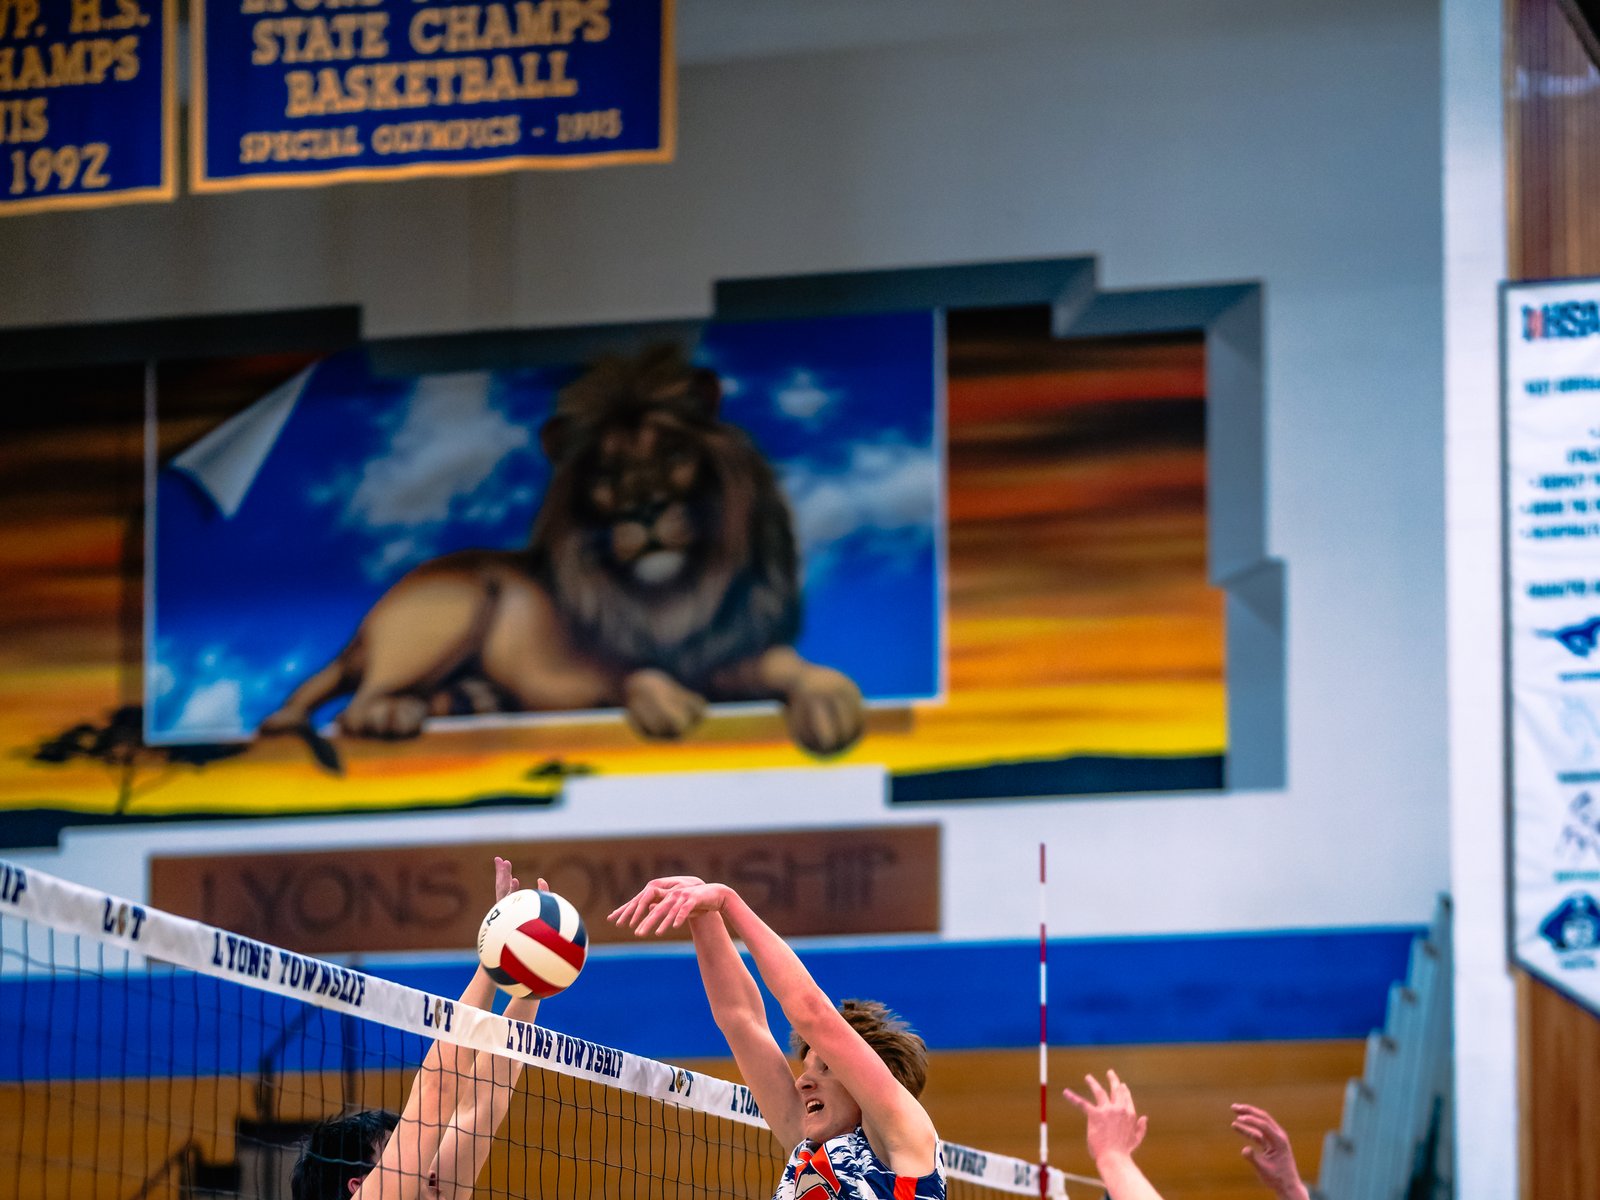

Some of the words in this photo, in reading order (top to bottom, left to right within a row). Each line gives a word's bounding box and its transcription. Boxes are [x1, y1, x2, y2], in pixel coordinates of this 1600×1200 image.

[252, 12, 389, 65] STATE
[409, 0, 611, 54] CHAMPS
[285, 50, 578, 118] BASKETBALL
[239, 125, 364, 164] SPECIAL
[371, 114, 521, 156] OLYMPICS
[9, 142, 111, 195] 1992
[213, 931, 272, 980] LYONS
[506, 1019, 553, 1060] LYONS
[556, 1033, 624, 1079] TOWNSHIP
